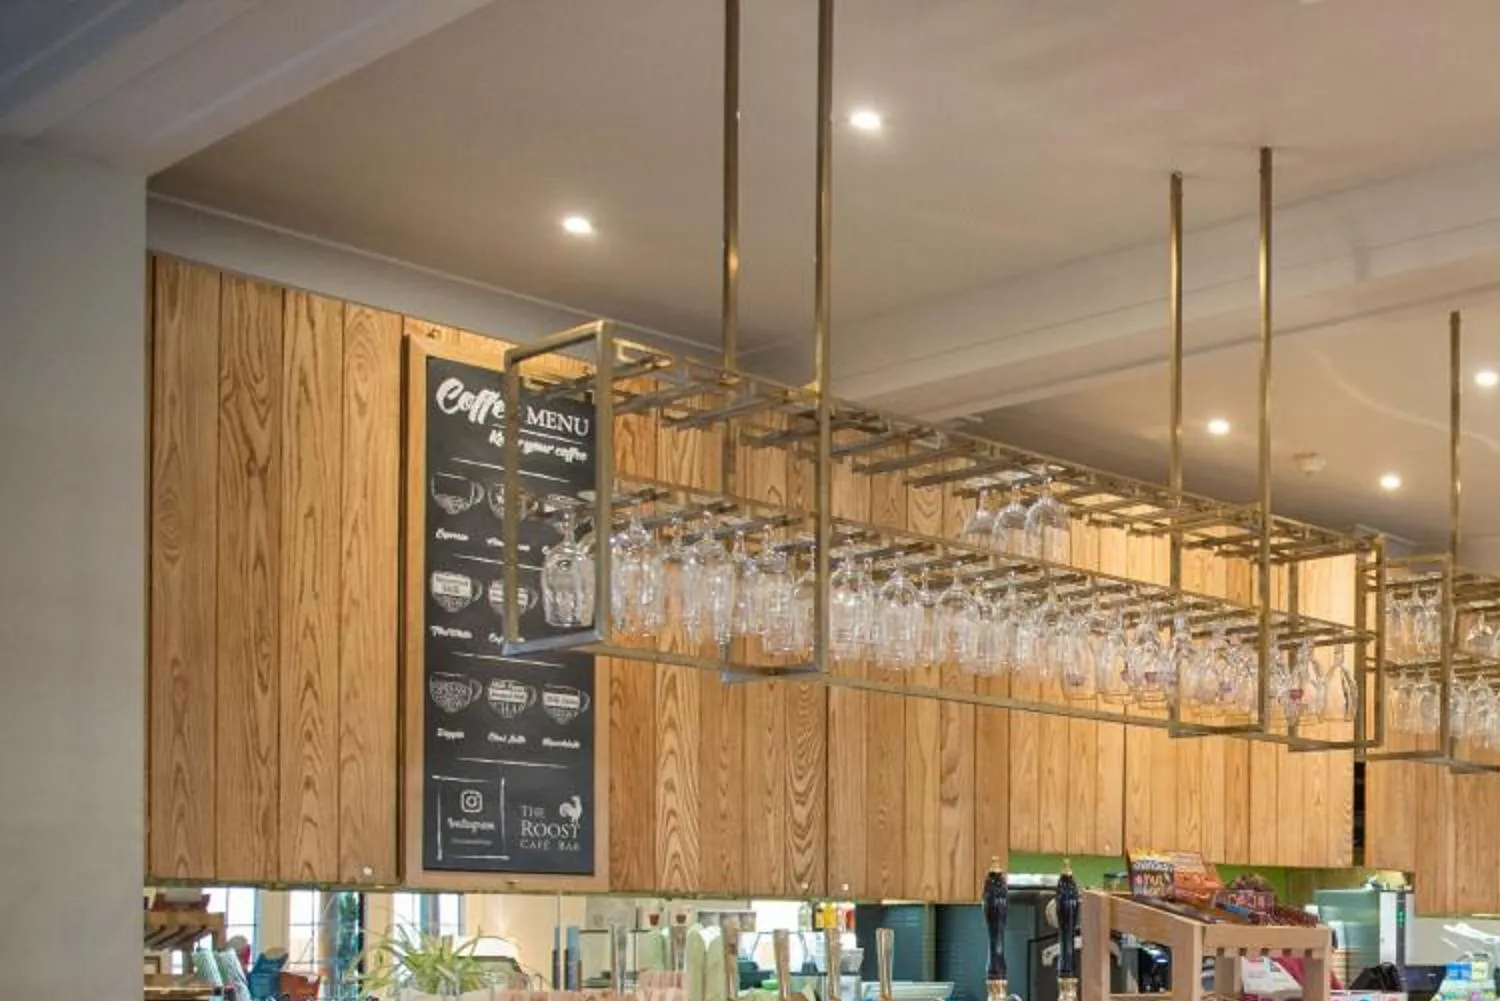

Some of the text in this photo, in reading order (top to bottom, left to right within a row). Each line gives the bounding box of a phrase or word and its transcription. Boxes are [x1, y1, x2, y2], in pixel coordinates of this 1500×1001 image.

[436, 377, 589, 437] Coffe MENU
[520, 805, 545, 818] THE
[521, 819, 580, 839] ROOST
